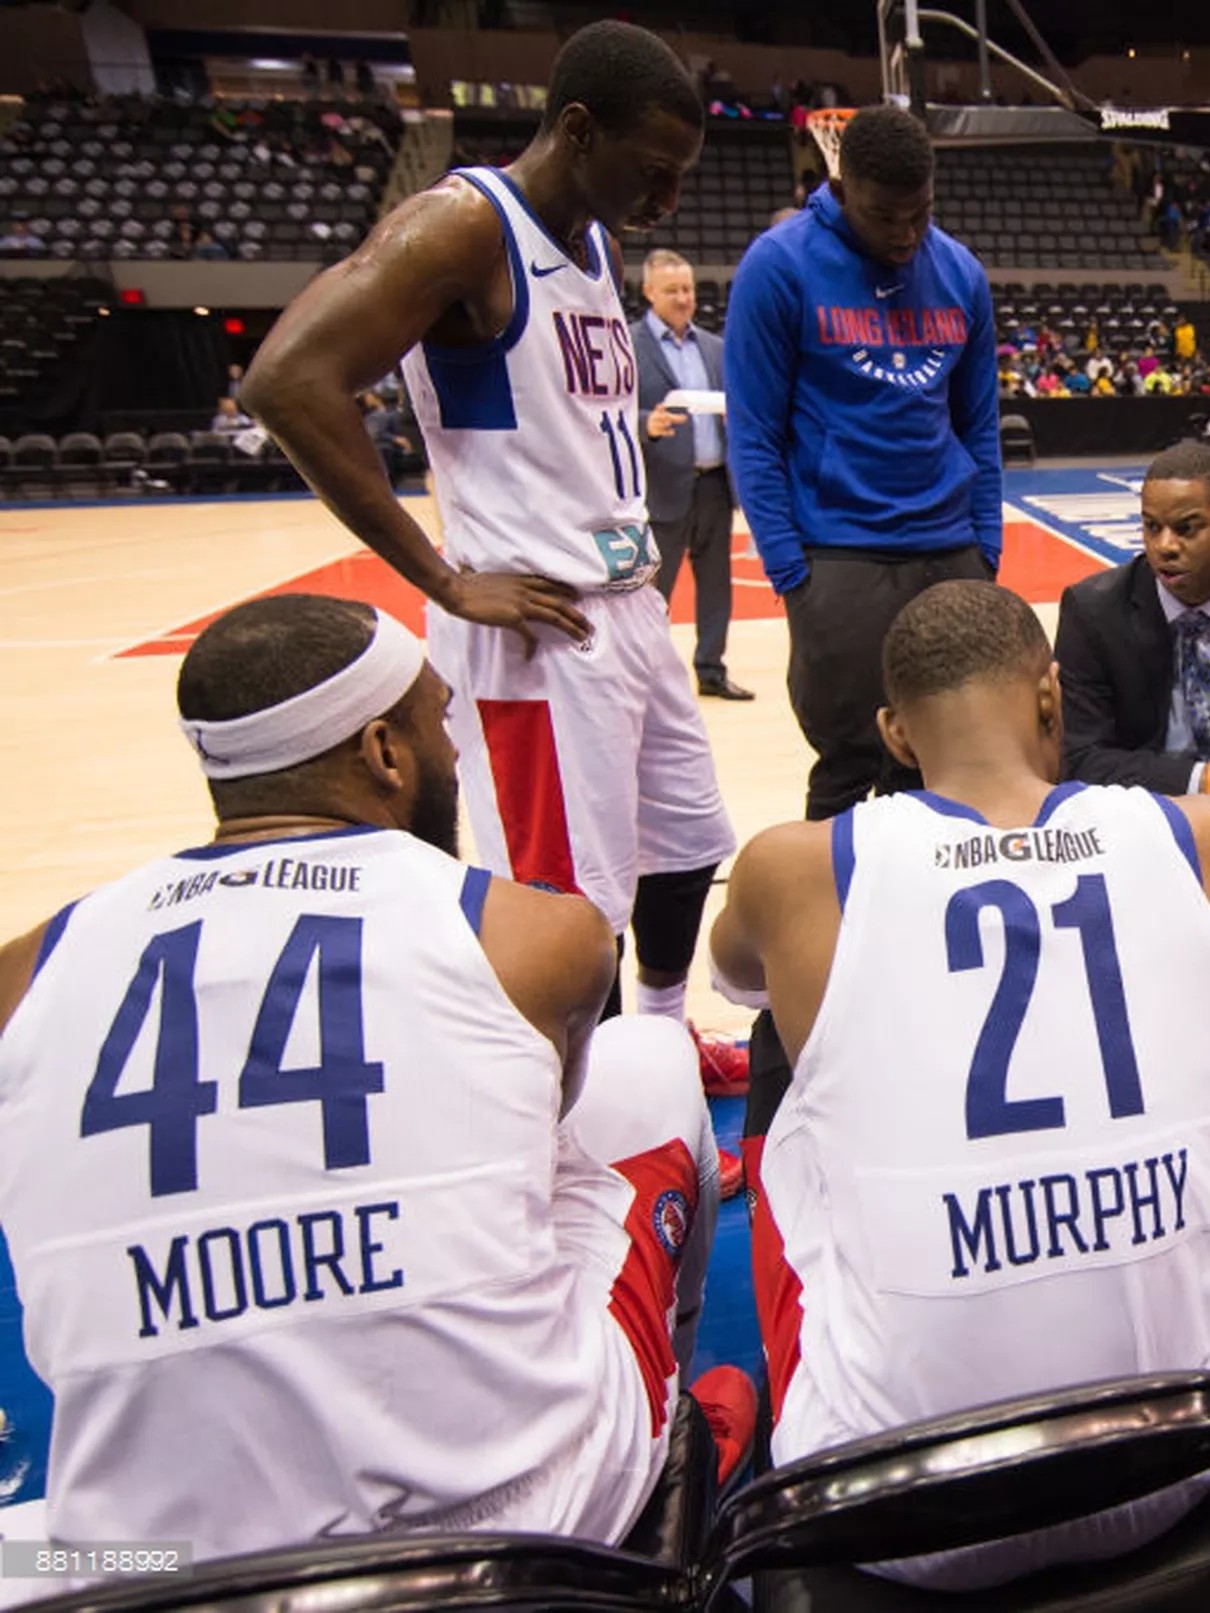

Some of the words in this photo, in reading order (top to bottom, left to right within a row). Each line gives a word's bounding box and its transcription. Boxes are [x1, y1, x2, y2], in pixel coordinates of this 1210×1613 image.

[817, 305, 883, 346] LONG
[600, 410, 641, 500] 11
[167, 869, 221, 907] NBA
[262, 857, 362, 892] LEAGUE
[954, 833, 998, 870] NBA
[999, 832, 1033, 862] G
[1033, 827, 1107, 864] LEAGUE
[80, 914, 386, 1198] 44
[943, 872, 1145, 1140] 21
[942, 1148, 1188, 1280] MURPHY
[127, 1201, 404, 1339] MOORE
